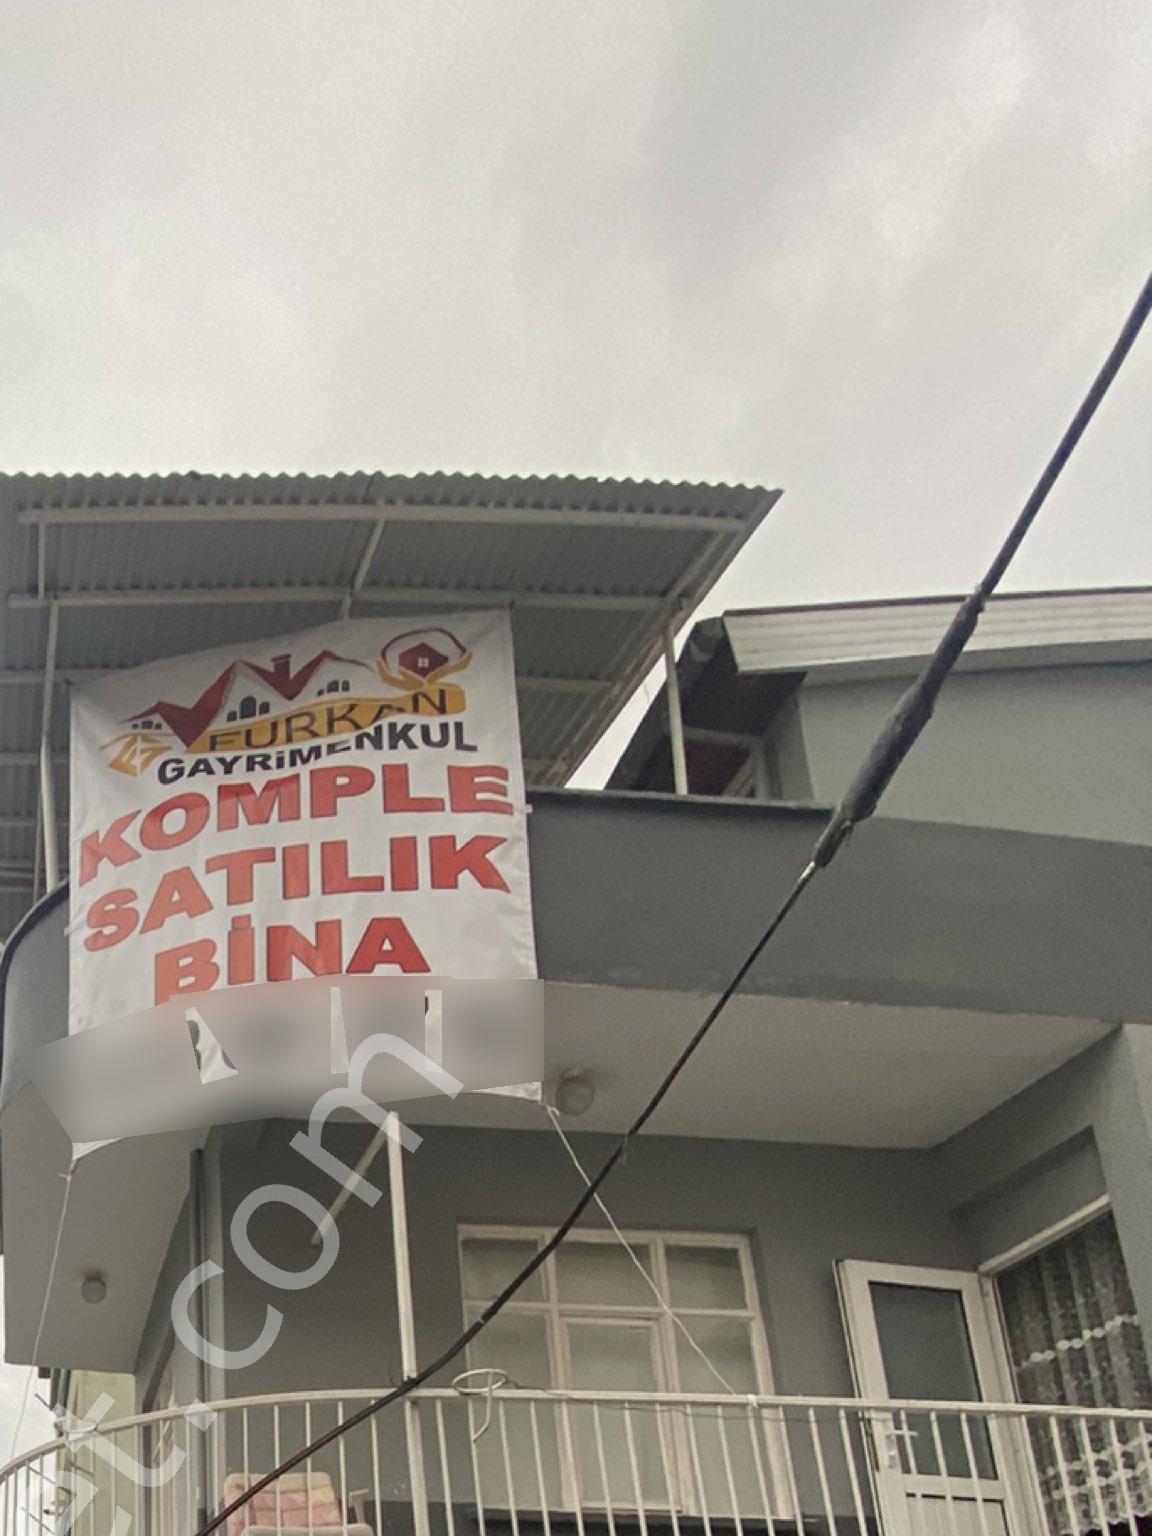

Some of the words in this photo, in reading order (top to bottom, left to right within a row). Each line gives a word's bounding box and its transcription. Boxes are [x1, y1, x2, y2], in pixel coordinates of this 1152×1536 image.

[78, 763, 515, 888] KOMPLE
[83, 834, 511, 953] SATILIK
[154, 913, 432, 1006] BİNA
